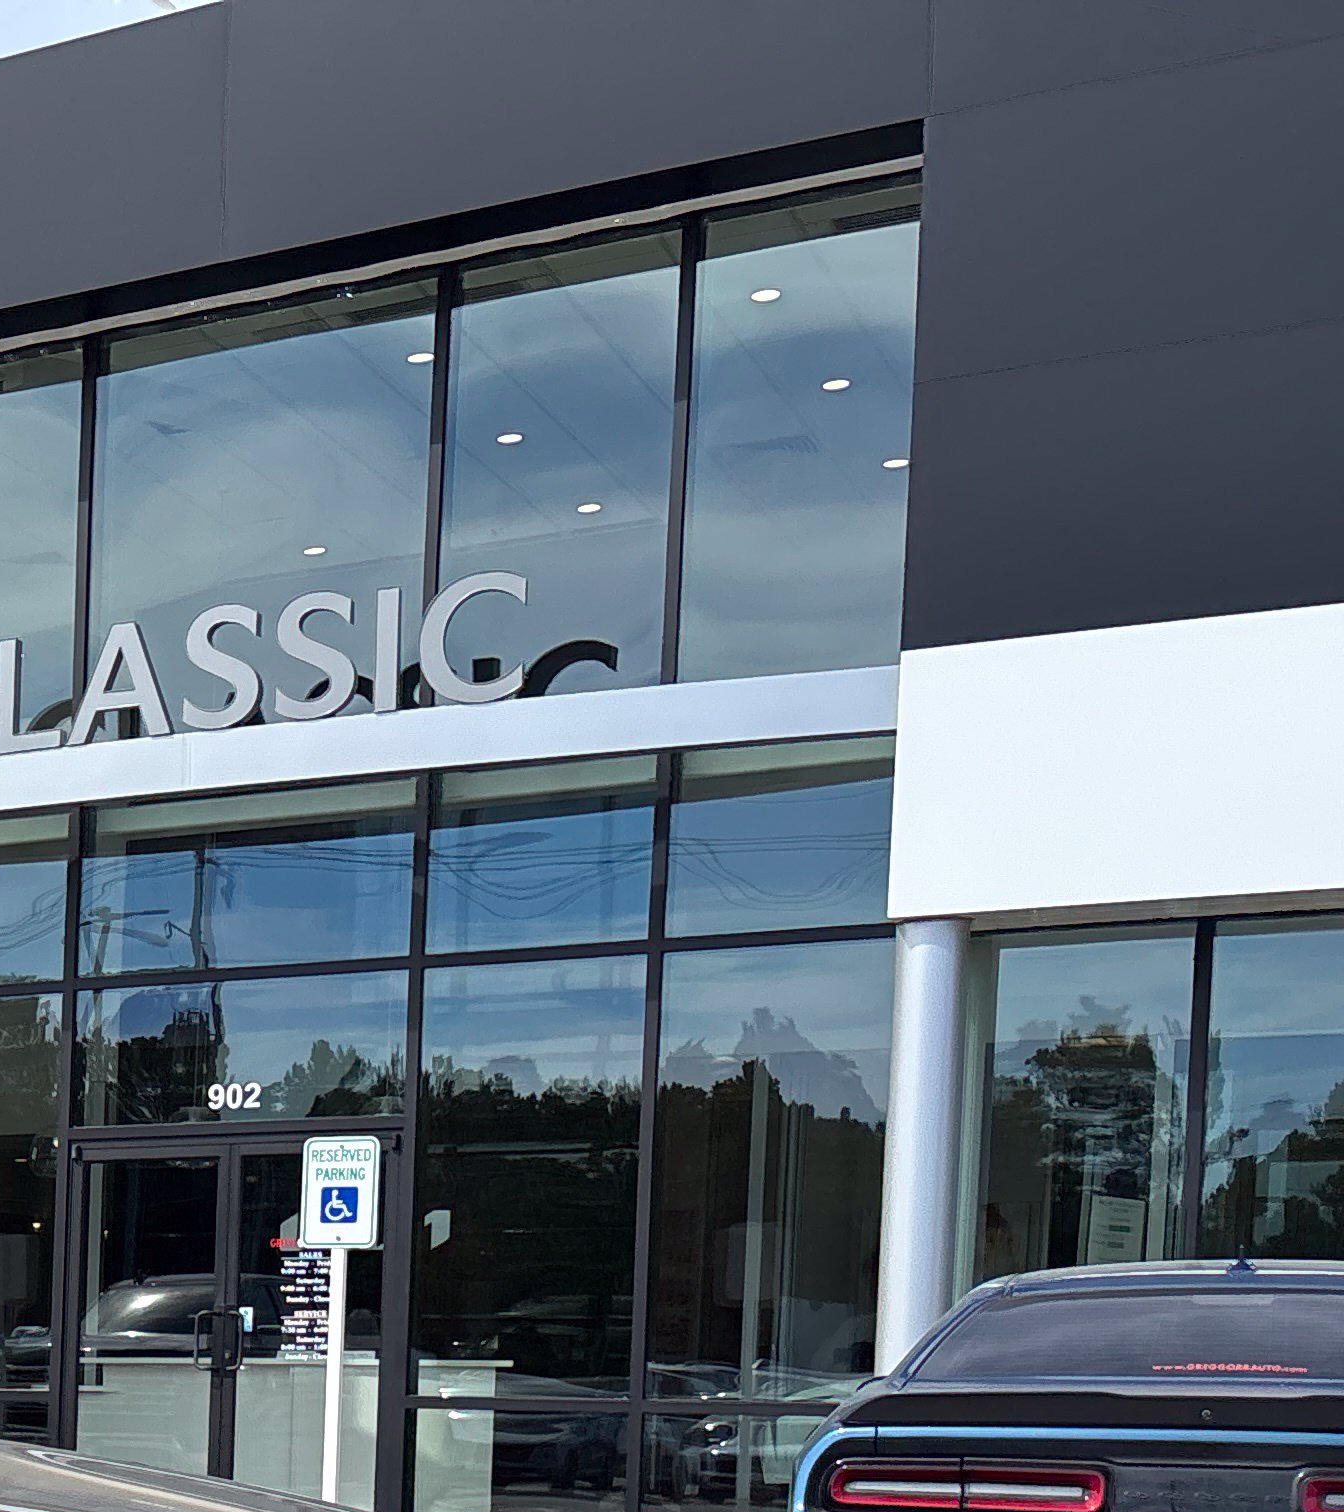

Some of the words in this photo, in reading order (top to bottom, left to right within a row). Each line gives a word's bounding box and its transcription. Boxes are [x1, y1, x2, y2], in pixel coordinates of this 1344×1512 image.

[207, 1082, 261, 1110] 902
[311, 1149, 372, 1163] RESERVED
[315, 1167, 366, 1181] PARKING
